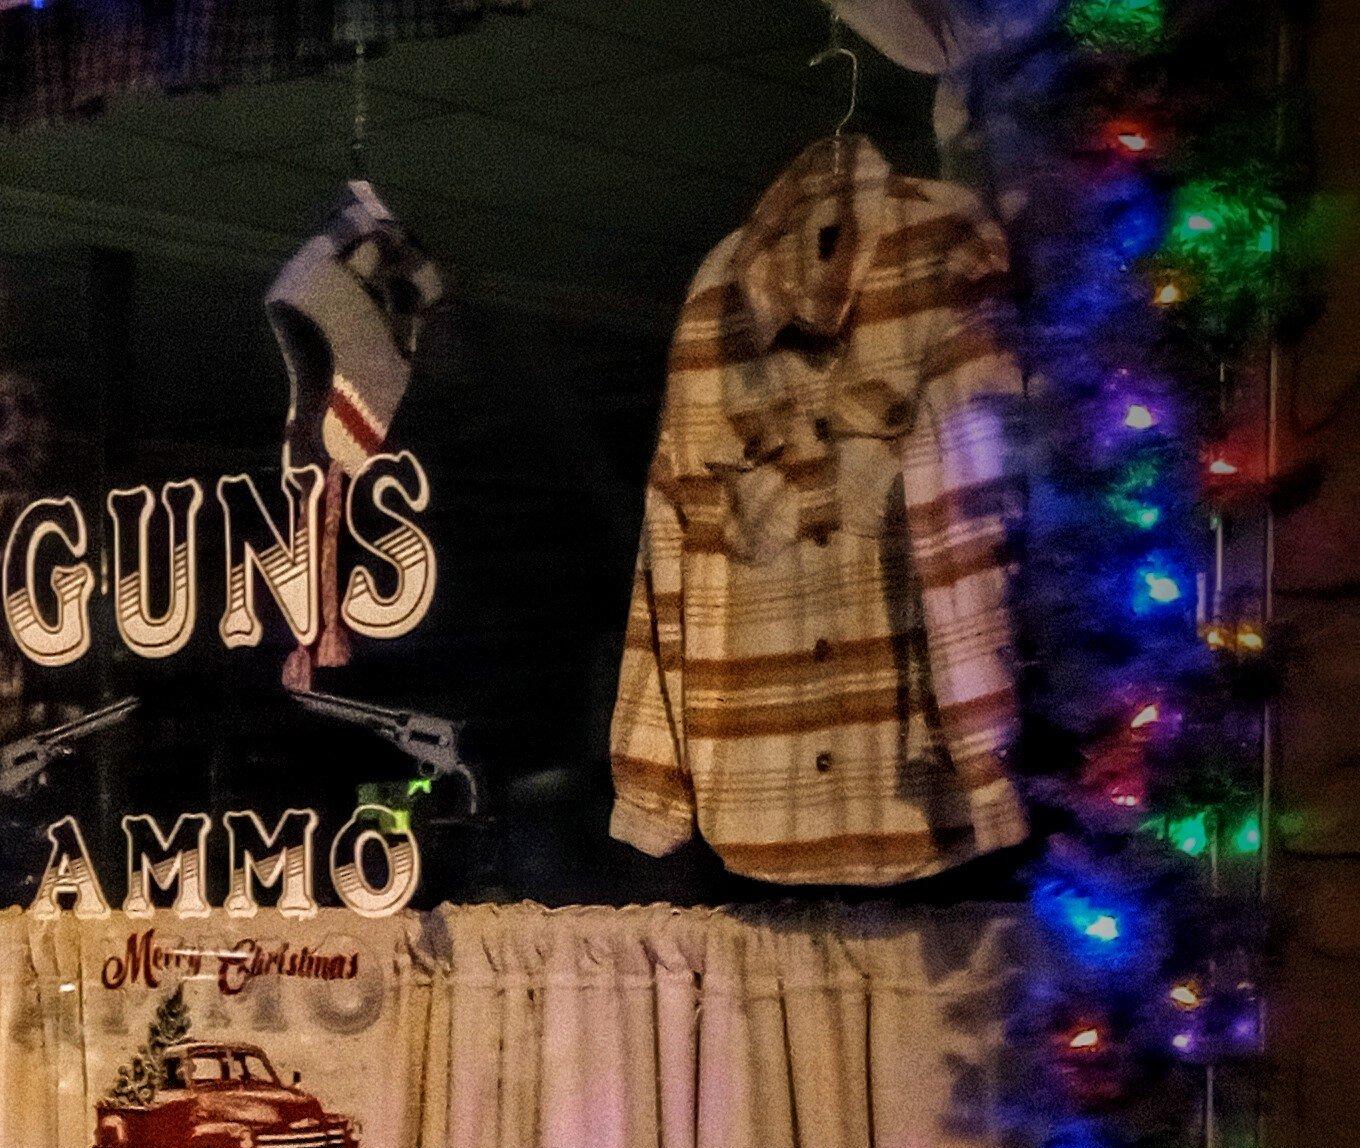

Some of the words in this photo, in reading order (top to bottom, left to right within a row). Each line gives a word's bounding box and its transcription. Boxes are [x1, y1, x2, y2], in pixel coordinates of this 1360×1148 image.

[2, 450, 437, 666] GUNS
[29, 804, 422, 919] AMMO
[100, 928, 202, 989] Merry
[218, 938, 360, 996] Christmas
